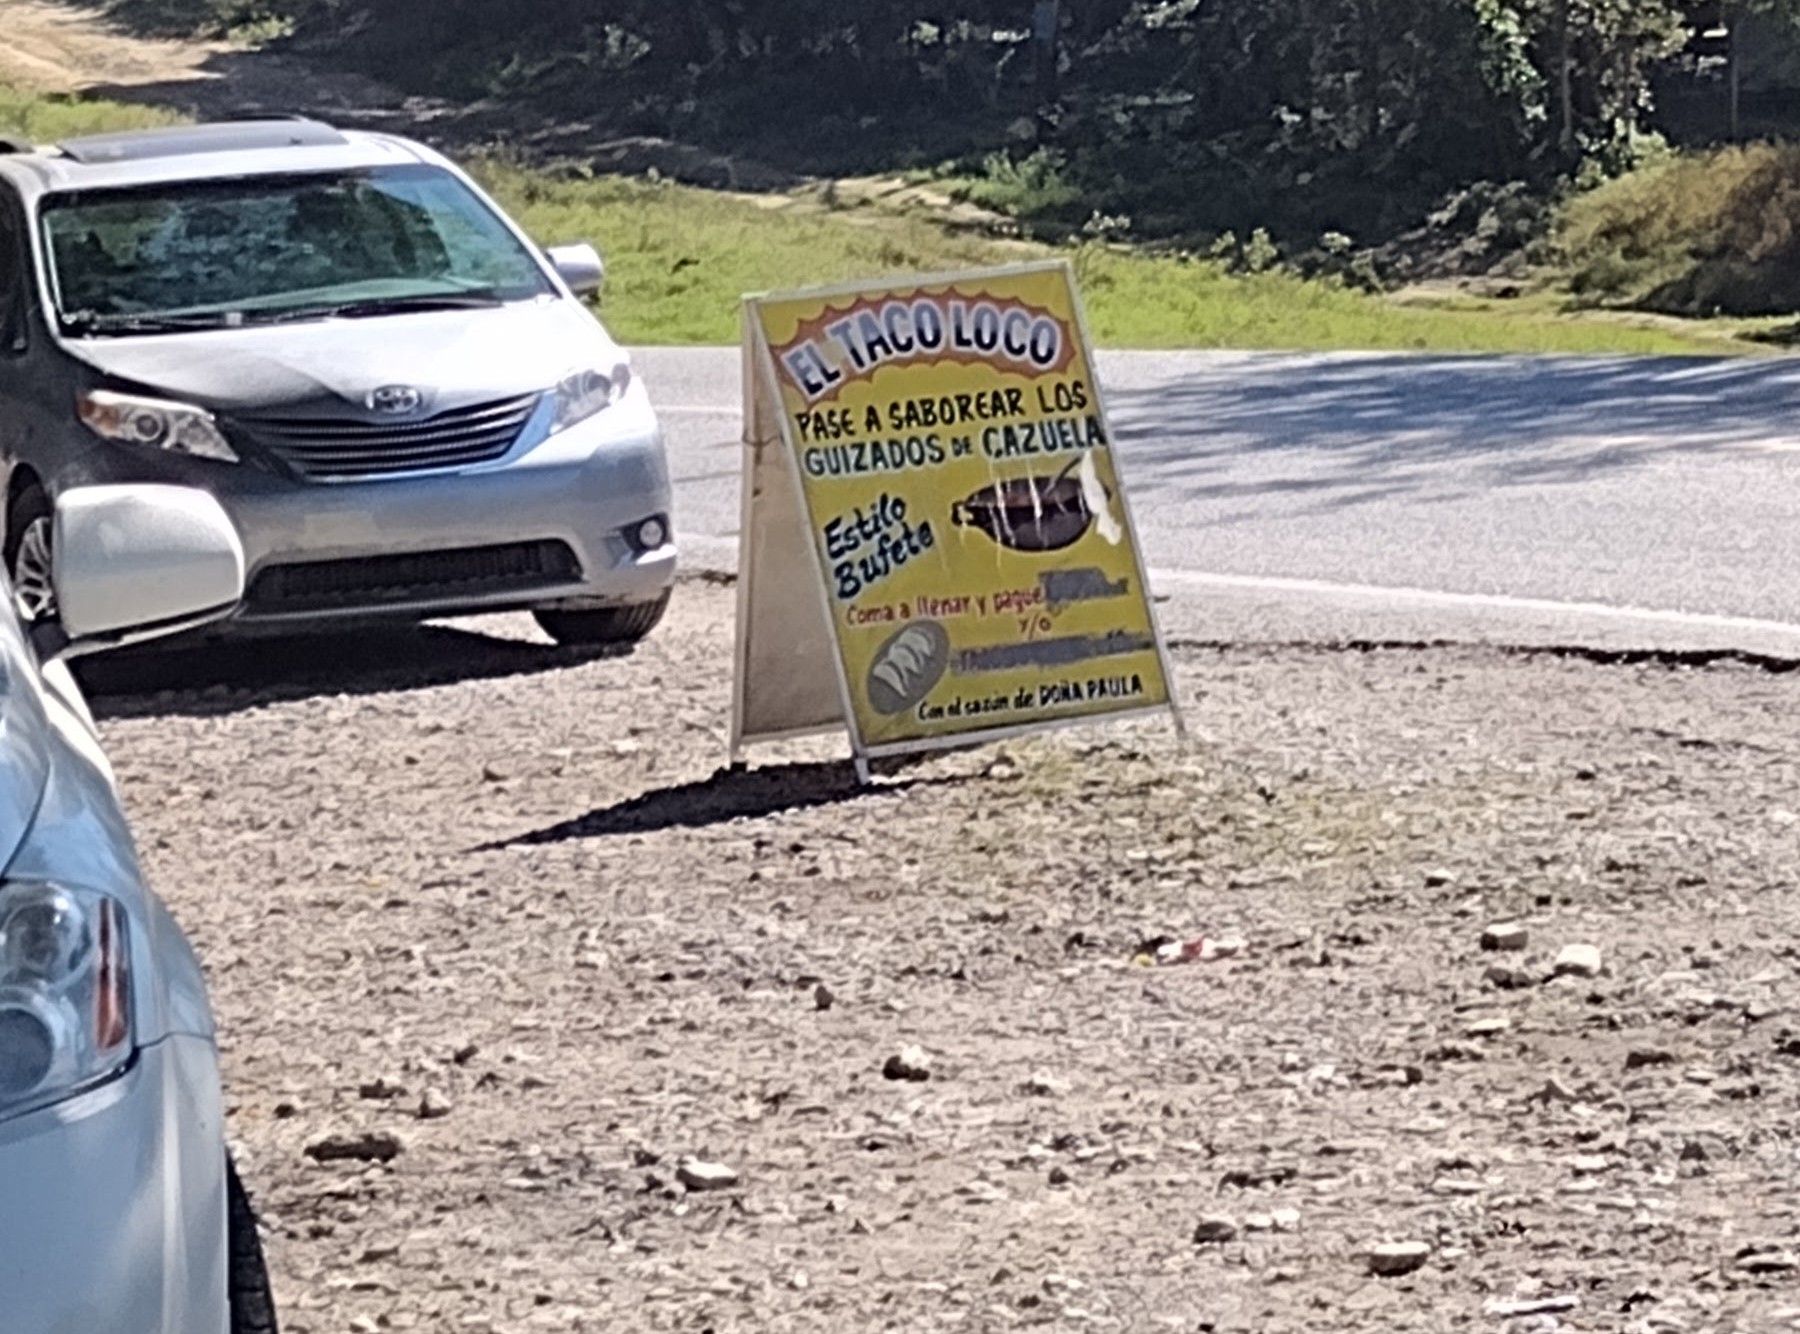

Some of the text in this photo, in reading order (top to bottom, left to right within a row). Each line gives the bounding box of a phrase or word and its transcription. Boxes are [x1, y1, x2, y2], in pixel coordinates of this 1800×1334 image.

[782, 302, 1059, 396] EL TACO LOCO
[795, 381, 1088, 443] PASE A SABOREAR LOS
[805, 415, 1106, 477] GUIZADOS DE CAZUELA
[824, 492, 906, 559] Estilo
[835, 520, 934, 599] Bufete
[847, 604, 893, 625] Coma
[900, 602, 911, 619] a
[917, 595, 971, 616] llenar
[994, 587, 1043, 615] pague
[919, 702, 944, 721] Con
[948, 697, 961, 718] el
[1014, 688, 1033, 710] de
[1040, 680, 1081, 706] DOÑA
[1087, 674, 1143, 698] PAULA
